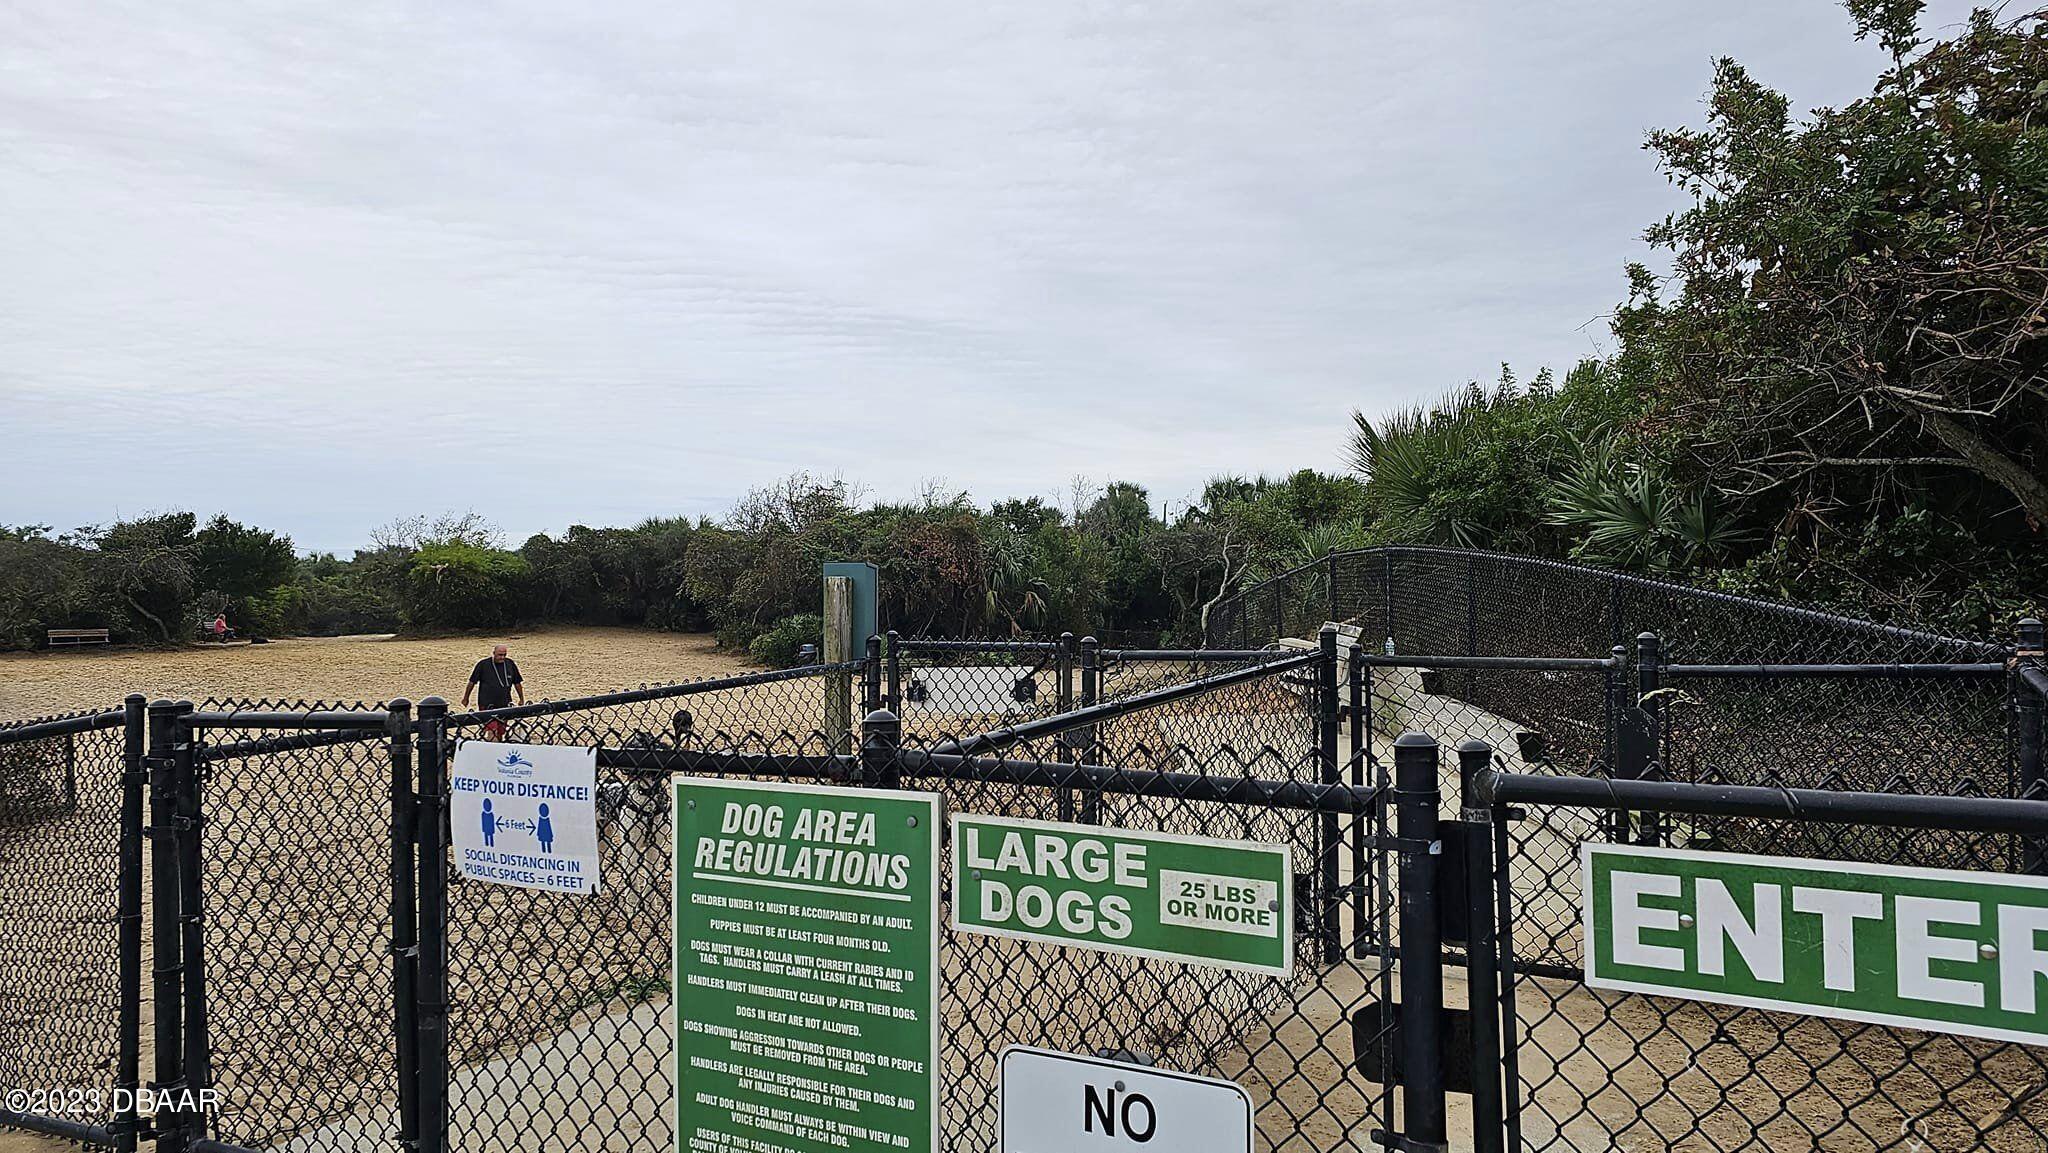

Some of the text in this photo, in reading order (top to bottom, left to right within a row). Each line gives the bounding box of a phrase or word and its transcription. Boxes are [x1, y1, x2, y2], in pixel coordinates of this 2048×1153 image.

[454, 776, 588, 801] KEEP YOUR DISTANCE!
[505, 820, 526, 830] 6 Feet
[722, 802, 876, 846] DOG AREA
[465, 849, 580, 872] SOCIAL DISTANCING IN
[465, 863, 497, 878] PUBLIC
[499, 868, 535, 884] SPACES
[547, 875, 554, 885] 6
[557, 875, 583, 889] FEET
[694, 837, 910, 890] REGULATIONS
[966, 828, 1149, 888] LARGE
[980, 879, 1133, 940] DOGS
[1180, 881, 1257, 904] 25 LBS
[691, 894, 913, 930] CHILDREN UNDER 12 MUST BE ACCOMPANIED BY AN ADULT.
[1167, 899, 1270, 926] OR MORE
[710, 919, 891, 952] PUPPIES MUST BE AT LEAST FOUR MONTHS OLD.
[691, 940, 913, 981] DOGS MUST WEAR A COLLAR WITH CURRENT RABIES AND ID
[699, 953, 903, 993] TAGS. HANDLERS MUST CARRY A LEASH AT ALL TIMES.
[688, 974, 918, 1020] HANDLERS MUST IMMEDIATELY CLEAN UP AFTER THEIR DOGS.
[736, 1006, 861, 1037] DOGS IN HEAT ARE NOT ALLOWED.
[684, 1020, 923, 1073] DOGS SHOWING AGGRESSION TOWARDS OTHER DOGS OR PEOPLE
[731, 1040, 868, 1076] MUST BE REMOVED FROM THE AREA.
[691, 1056, 915, 1110] HANDLERS ARE LEGALLY RESPONSIBLE FOR THEIR DOGS AND
[738, 1078, 859, 1112] ANY INJURIES CAUSED BY THEM.
[696, 1092, 909, 1148] ADULT DOG HANDLER MUST ALWAYS BE WITHIN VIEW AND
[731, 1112, 850, 1147] VOICE COMMAND OF EACH DOG.
[1084, 1084, 1157, 1143] NO
[689, 1137, 717, 1153] COUNTY
[697, 1128, 719, 1142] USERS
[721, 1133, 731, 1144] OF
[732, 1136, 749, 1149] THIS
[751, 1141, 783, 1153] FACILITY
